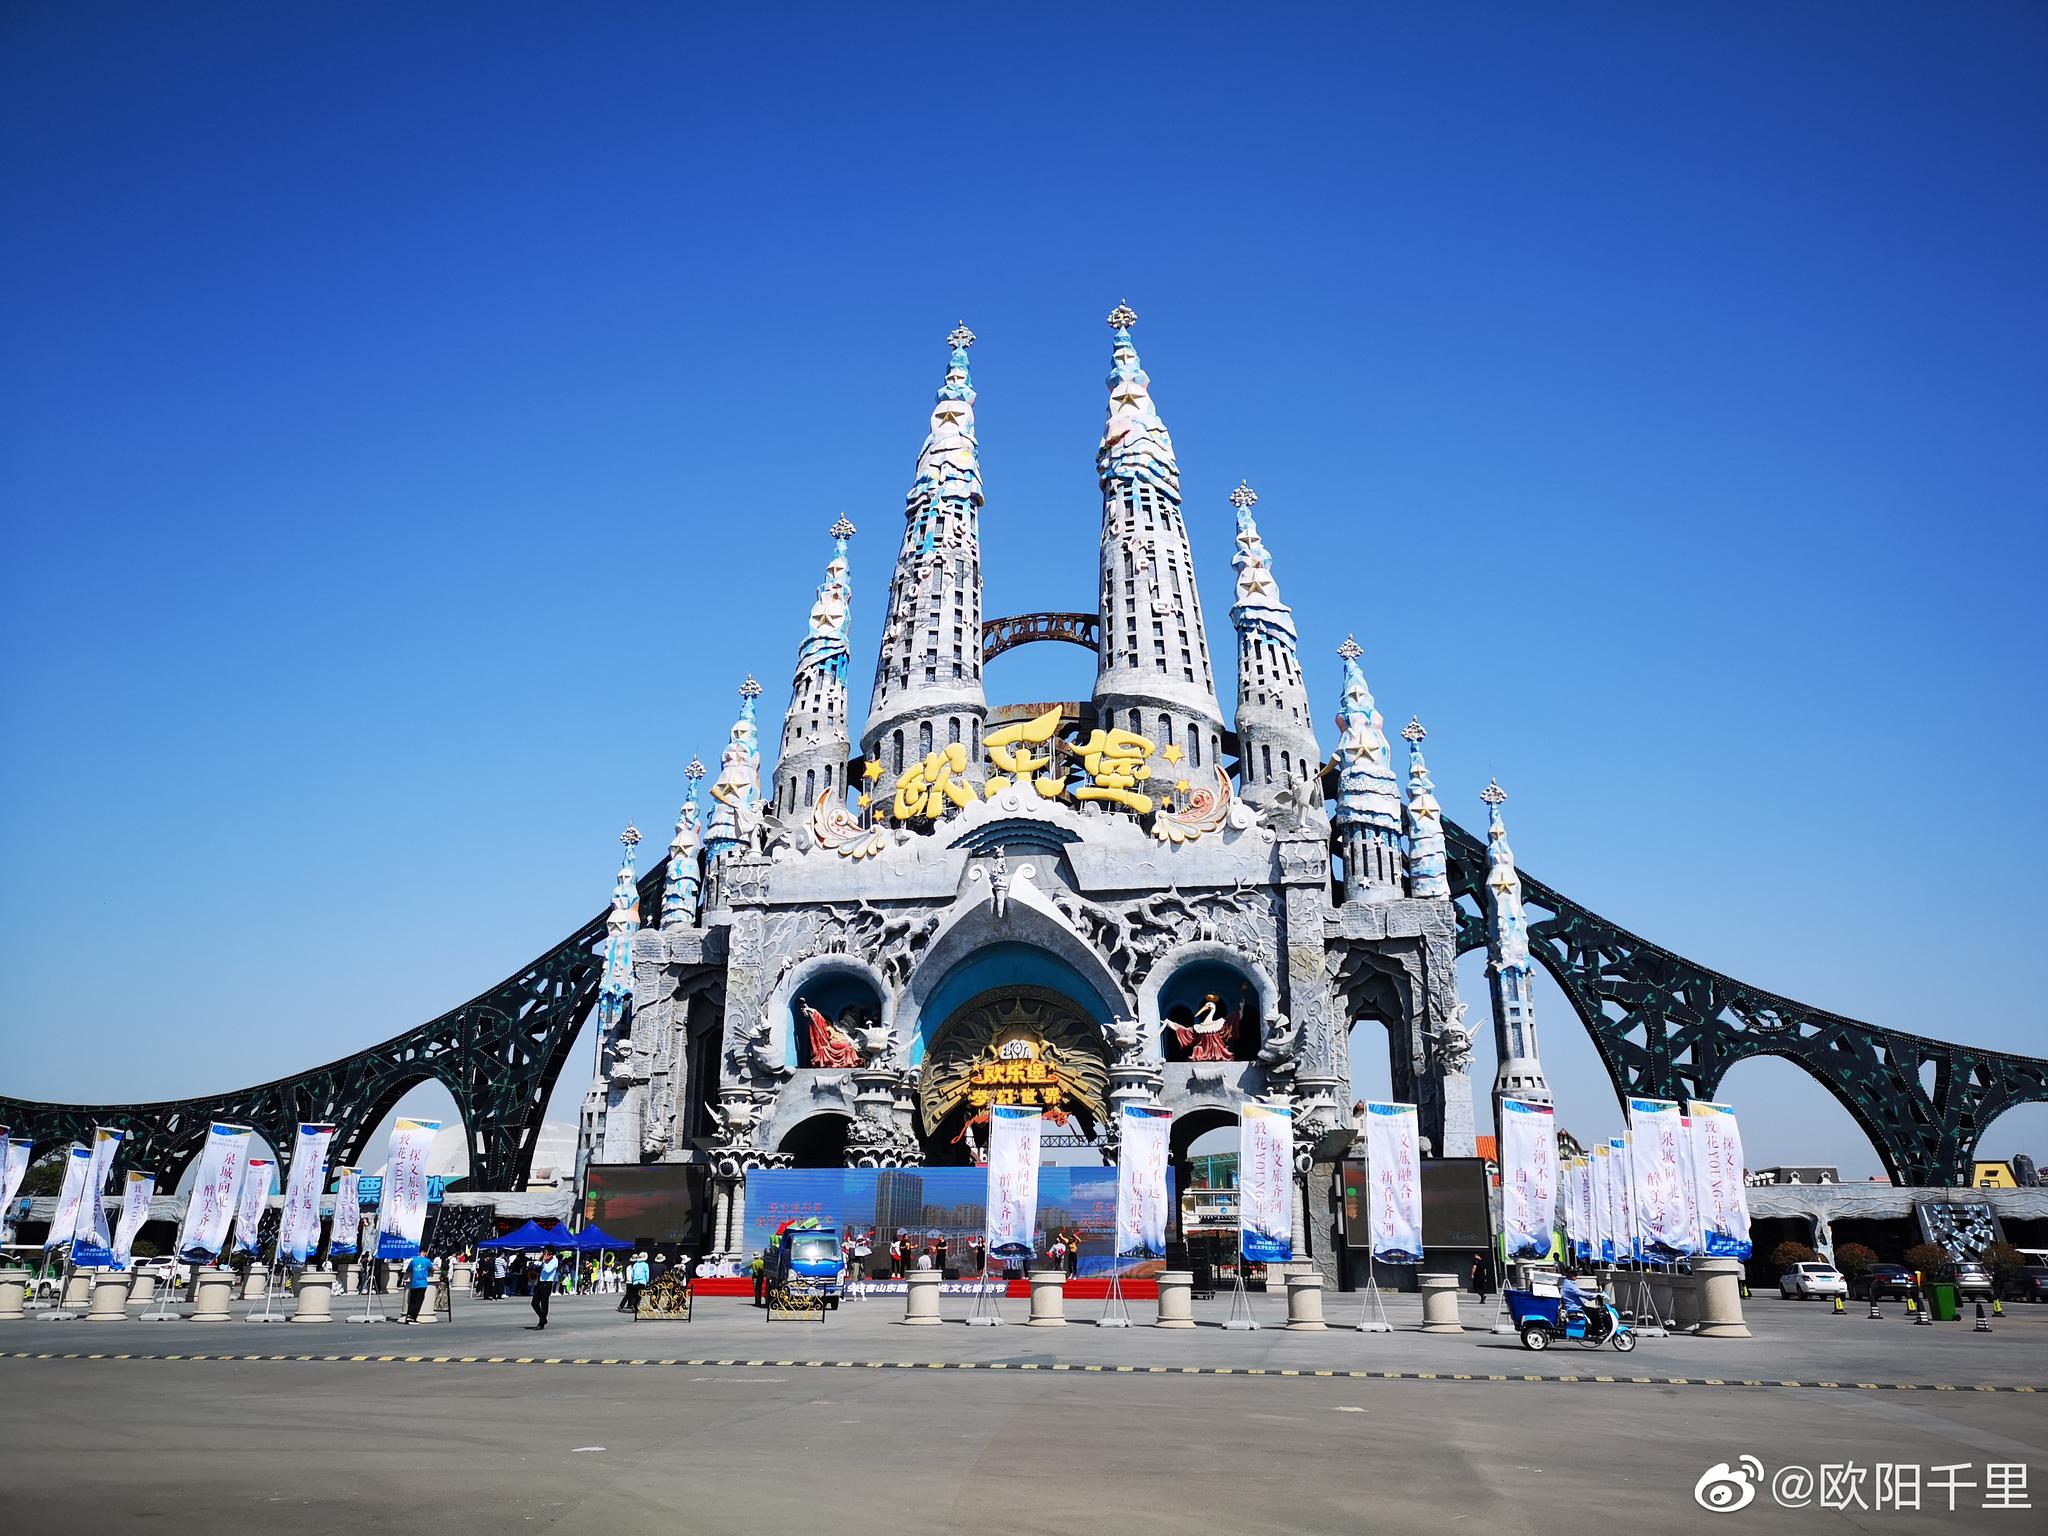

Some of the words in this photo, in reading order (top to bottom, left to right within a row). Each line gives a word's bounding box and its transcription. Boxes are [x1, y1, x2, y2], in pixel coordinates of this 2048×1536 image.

[969, 1087, 1062, 1107] 梦幻世界
[983, 1063, 1047, 1084] 欧乐堡
[217, 1152, 237, 1208] 泉城向北
[1017, 1135, 1032, 1197] 泉城向北
[1149, 1136, 1162, 1199] 齐河不远
[1398, 1133, 1413, 1199] 文旅融合
[1534, 1132, 1548, 1200] 齐河不远
[1662, 1131, 1680, 1199] 泉城向北
[193, 1184, 216, 1242] 醉美齐河
[998, 1173, 1013, 1237] 醉美齐河
[1129, 1171, 1143, 1235] 自然很近
